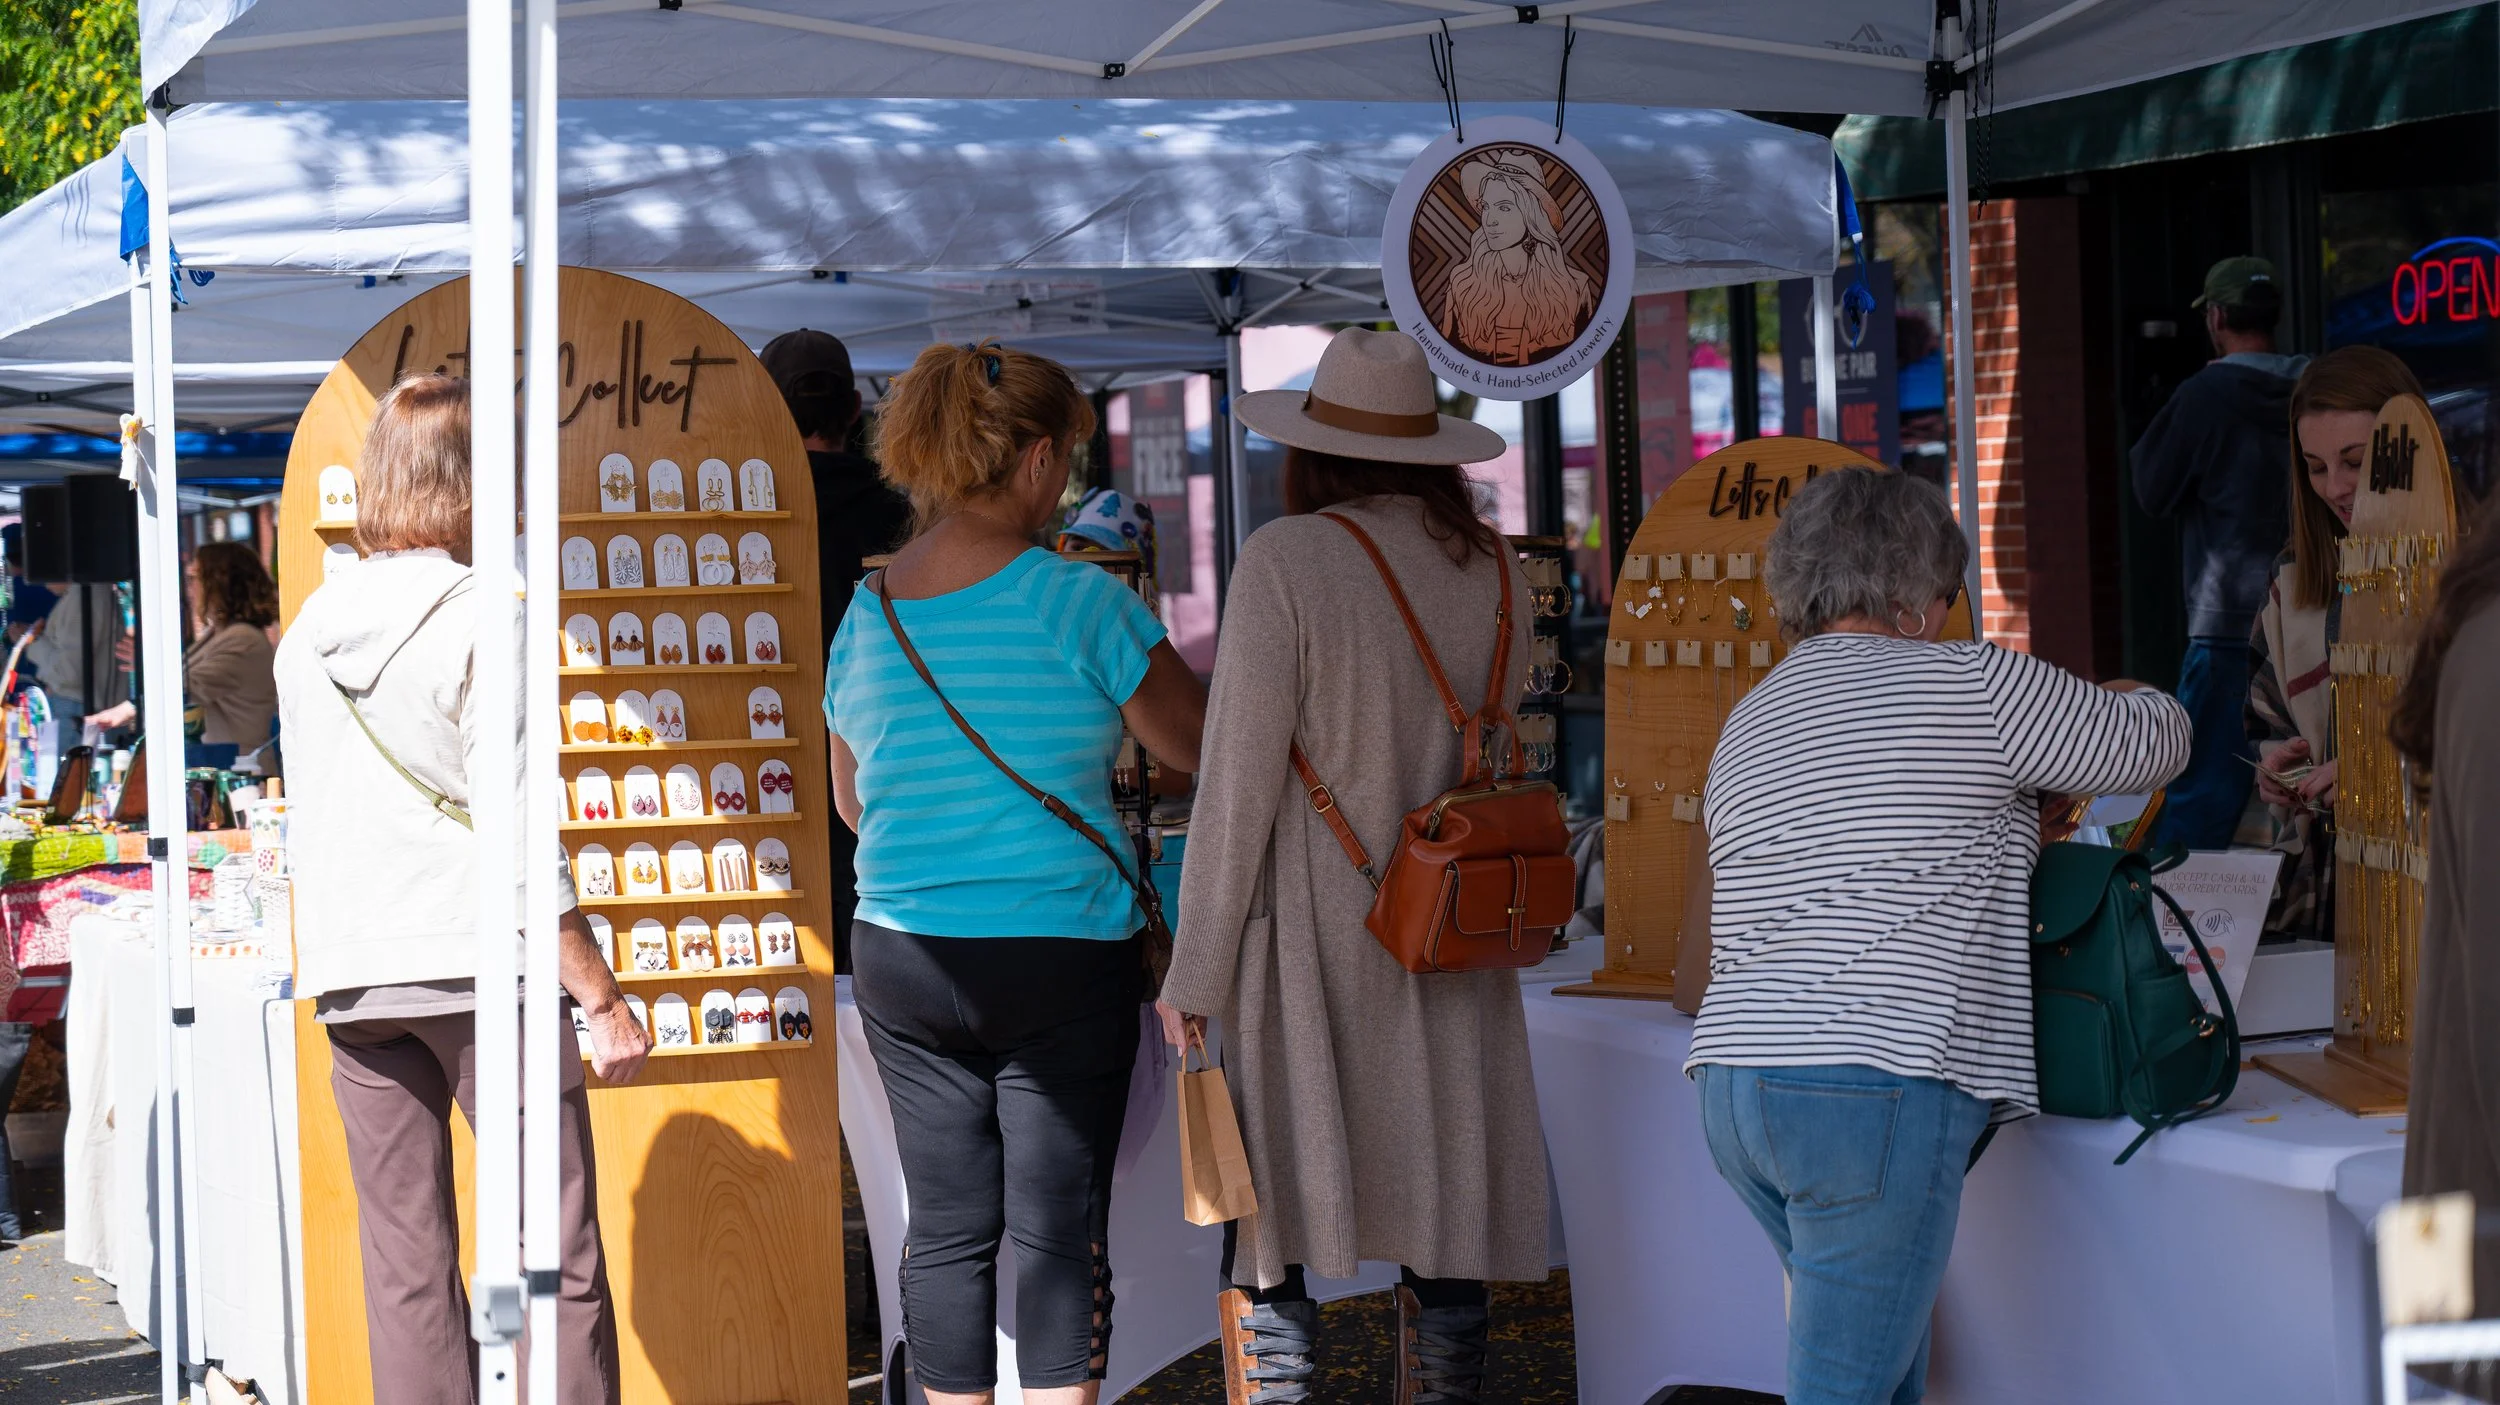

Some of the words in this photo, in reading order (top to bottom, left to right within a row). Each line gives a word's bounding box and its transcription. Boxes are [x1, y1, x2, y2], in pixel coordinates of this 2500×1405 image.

[2391, 255, 2500, 325] OPEN
[1411, 321, 1470, 378] Handmade
[1471, 370, 1482, 384] &
[1486, 354, 1578, 389] Hand-Selected
[1575, 317, 1615, 361] Jewelry
[2172, 871, 2211, 884] ACCEPT
[2210, 873, 2239, 884] CASH
[2240, 874, 2247, 884] &
[2250, 874, 2268, 884] ALL
[2187, 882, 2221, 895] CREDIT
[2223, 884, 2258, 896] CARDS
